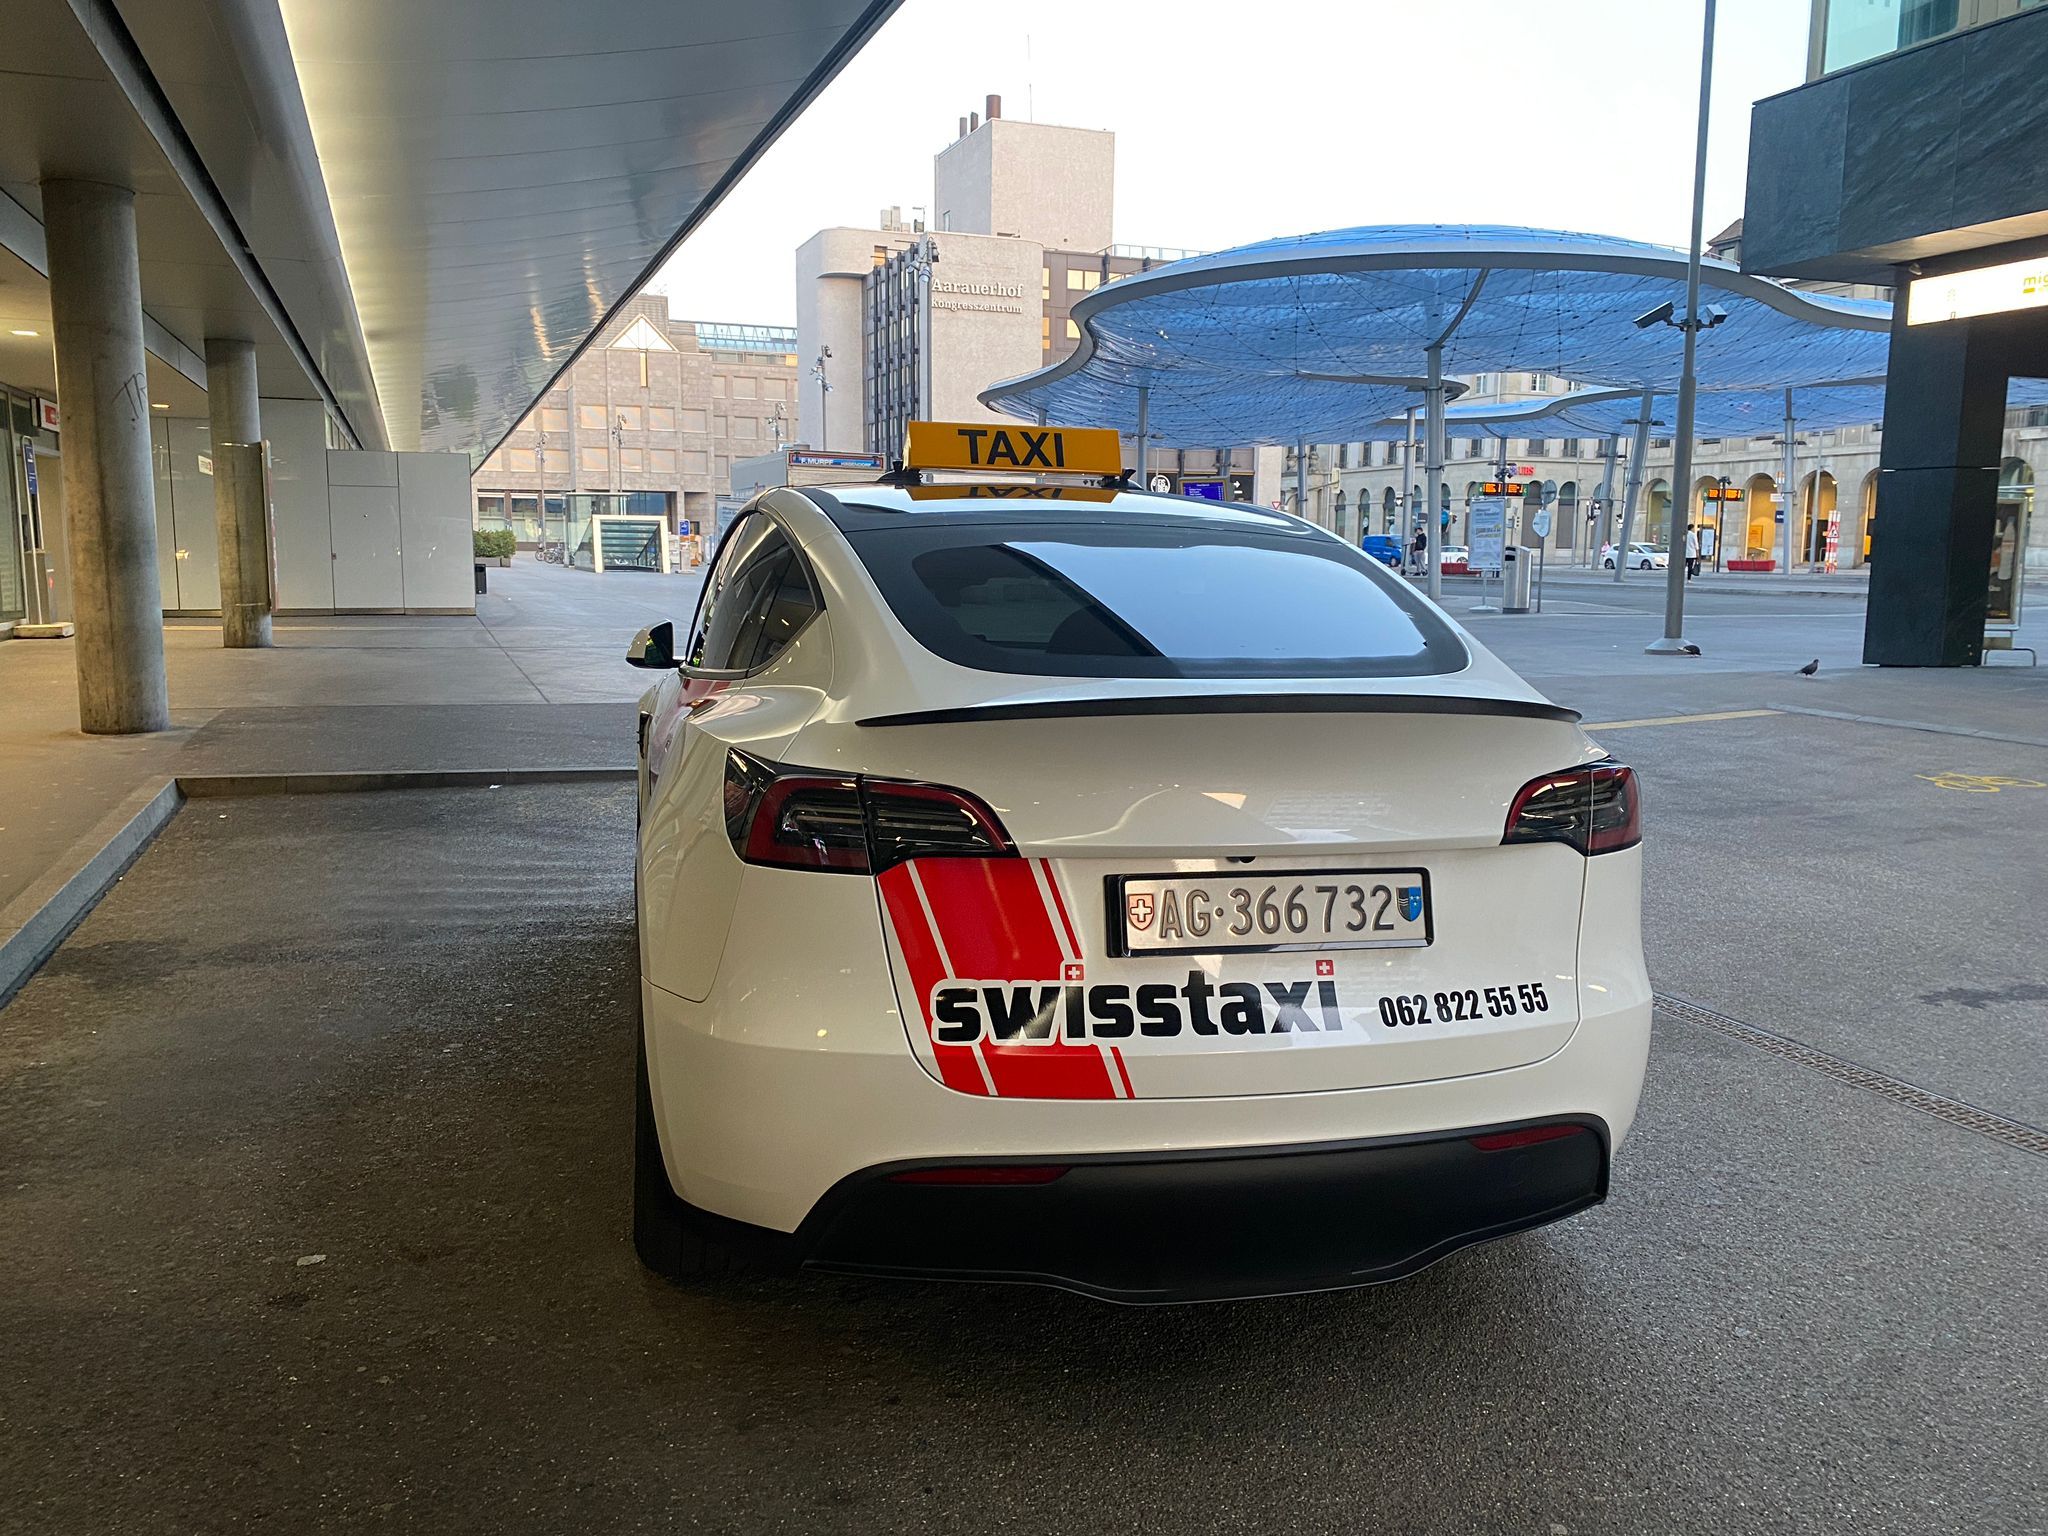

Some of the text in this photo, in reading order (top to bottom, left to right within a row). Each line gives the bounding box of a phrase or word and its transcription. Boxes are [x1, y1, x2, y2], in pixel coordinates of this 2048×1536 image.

[931, 278, 1024, 298] Aarauerhof
[957, 428, 1065, 468] TAXI
[935, 960, 1343, 1043] swisstaxi
[1378, 982, 1549, 1028] 062 822 55 55
